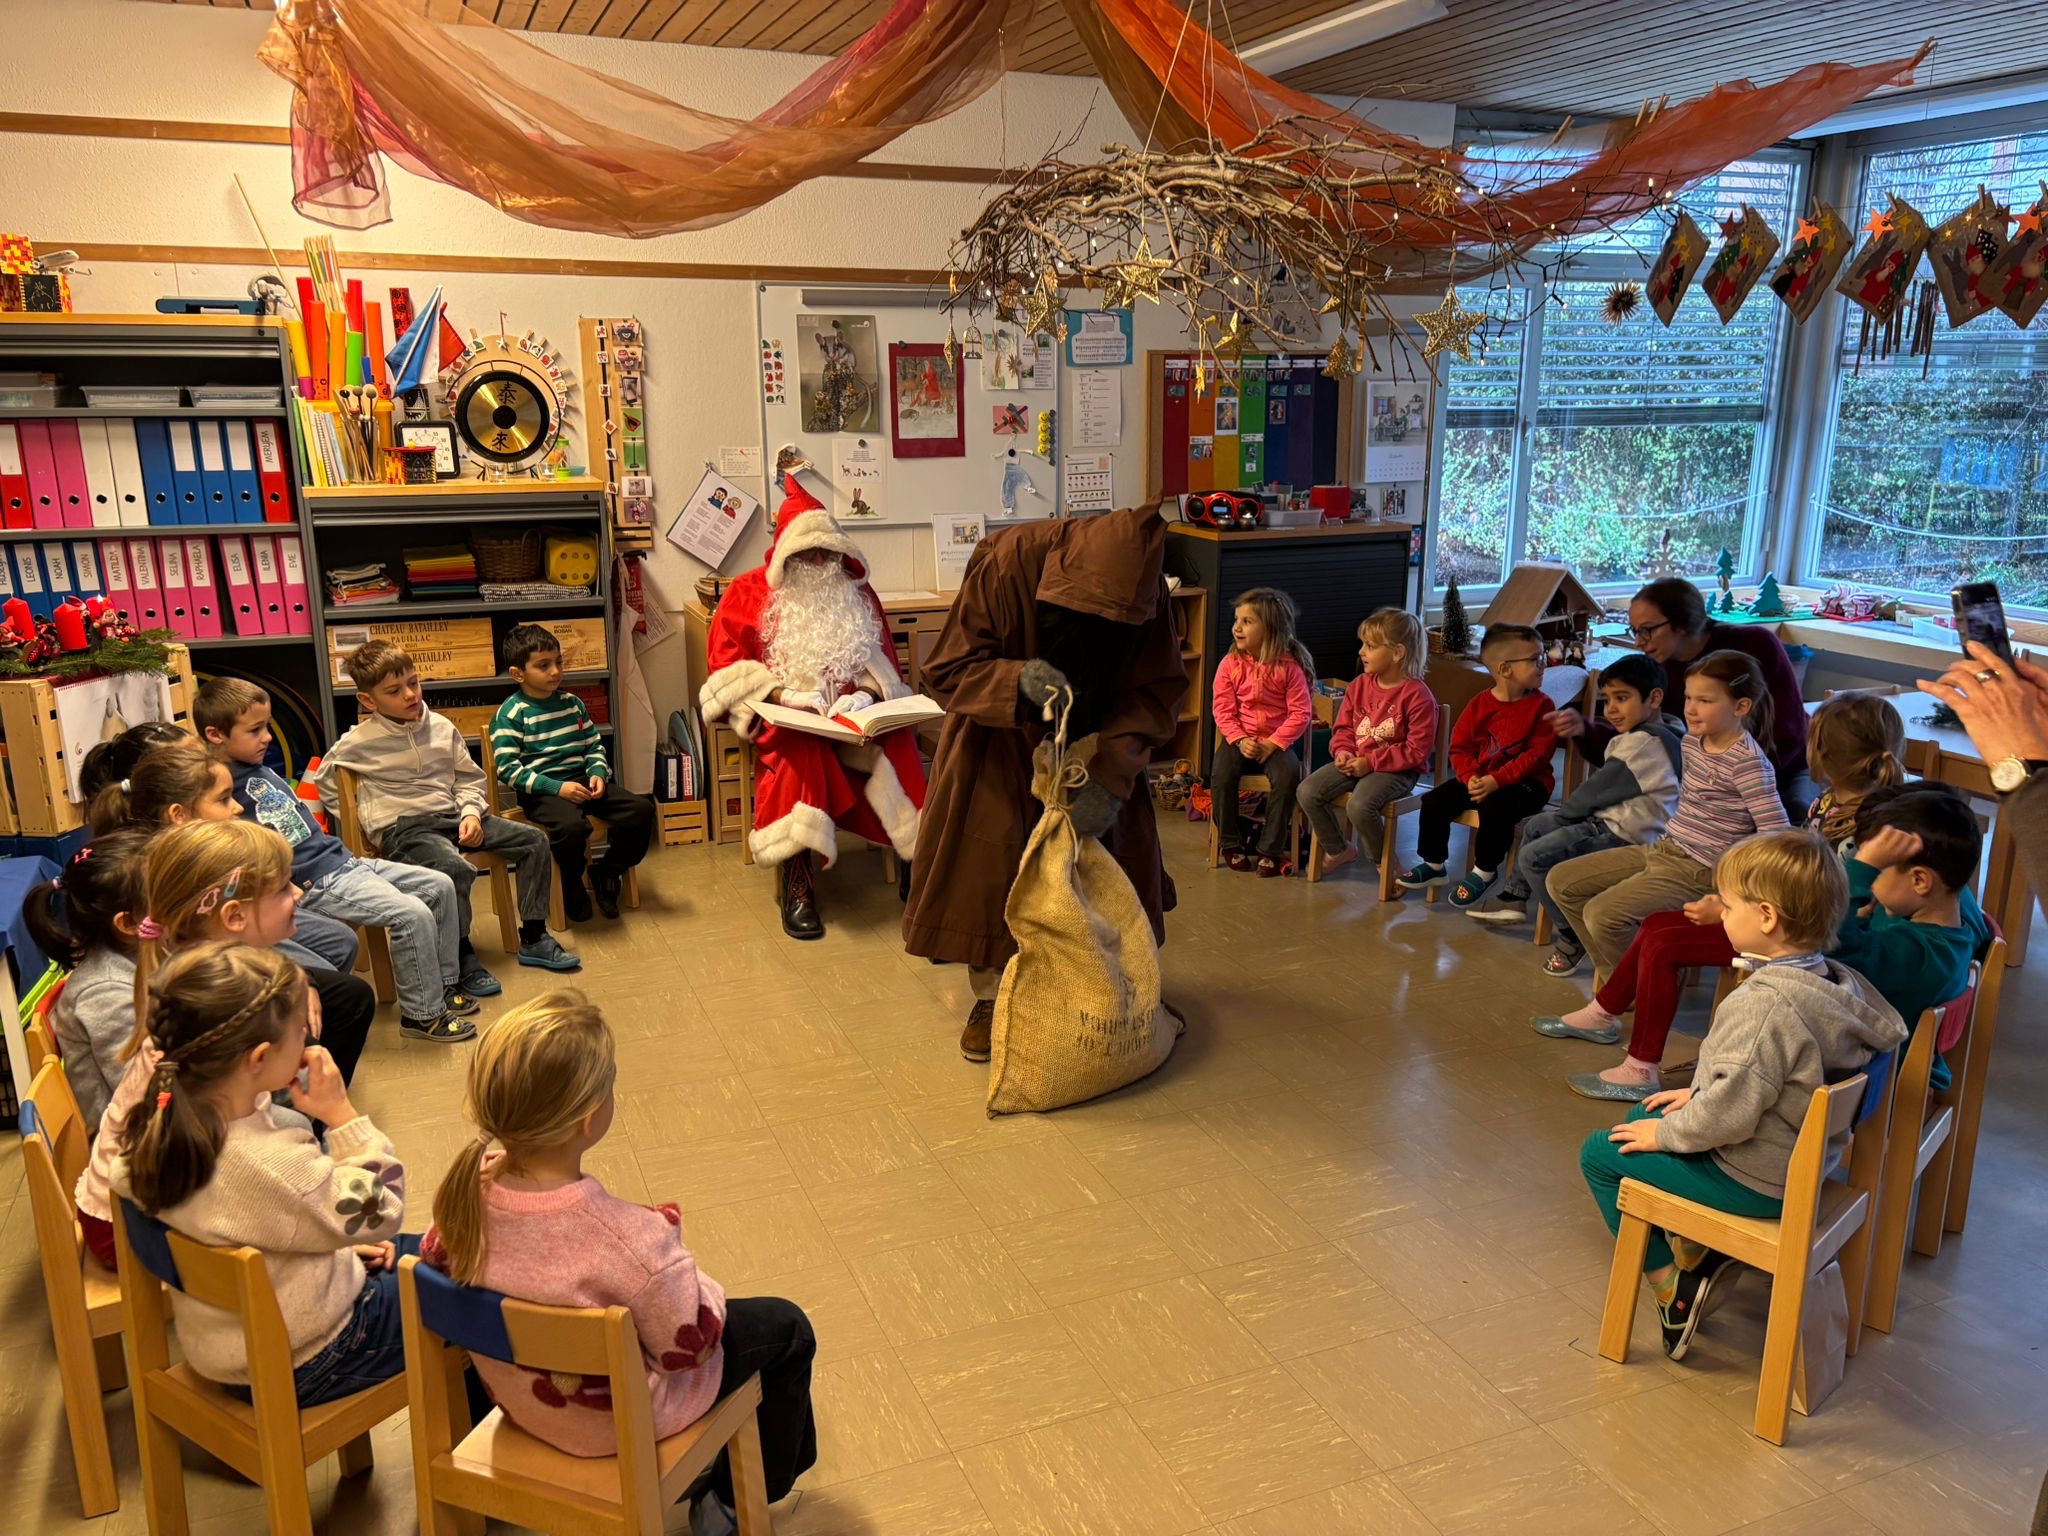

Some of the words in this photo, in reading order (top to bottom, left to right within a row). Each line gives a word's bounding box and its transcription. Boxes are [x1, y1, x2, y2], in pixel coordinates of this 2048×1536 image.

[22, 556, 36, 582] LEONIS
[51, 558, 64, 579] NOAH
[80, 553, 92, 578] SIMON
[109, 550, 122, 582] MATILDA
[136, 546, 150, 585] VALENTINA
[168, 552, 179, 576] SELINA
[192, 544, 205, 580] RAPHAELA
[231, 553, 242, 572] ELISA
[288, 553, 298, 568] EVIE
[408, 621, 449, 633] BATAILLEY
[390, 634, 431, 643] PAUILLAC
[412, 651, 452, 663] BATAILLEY
